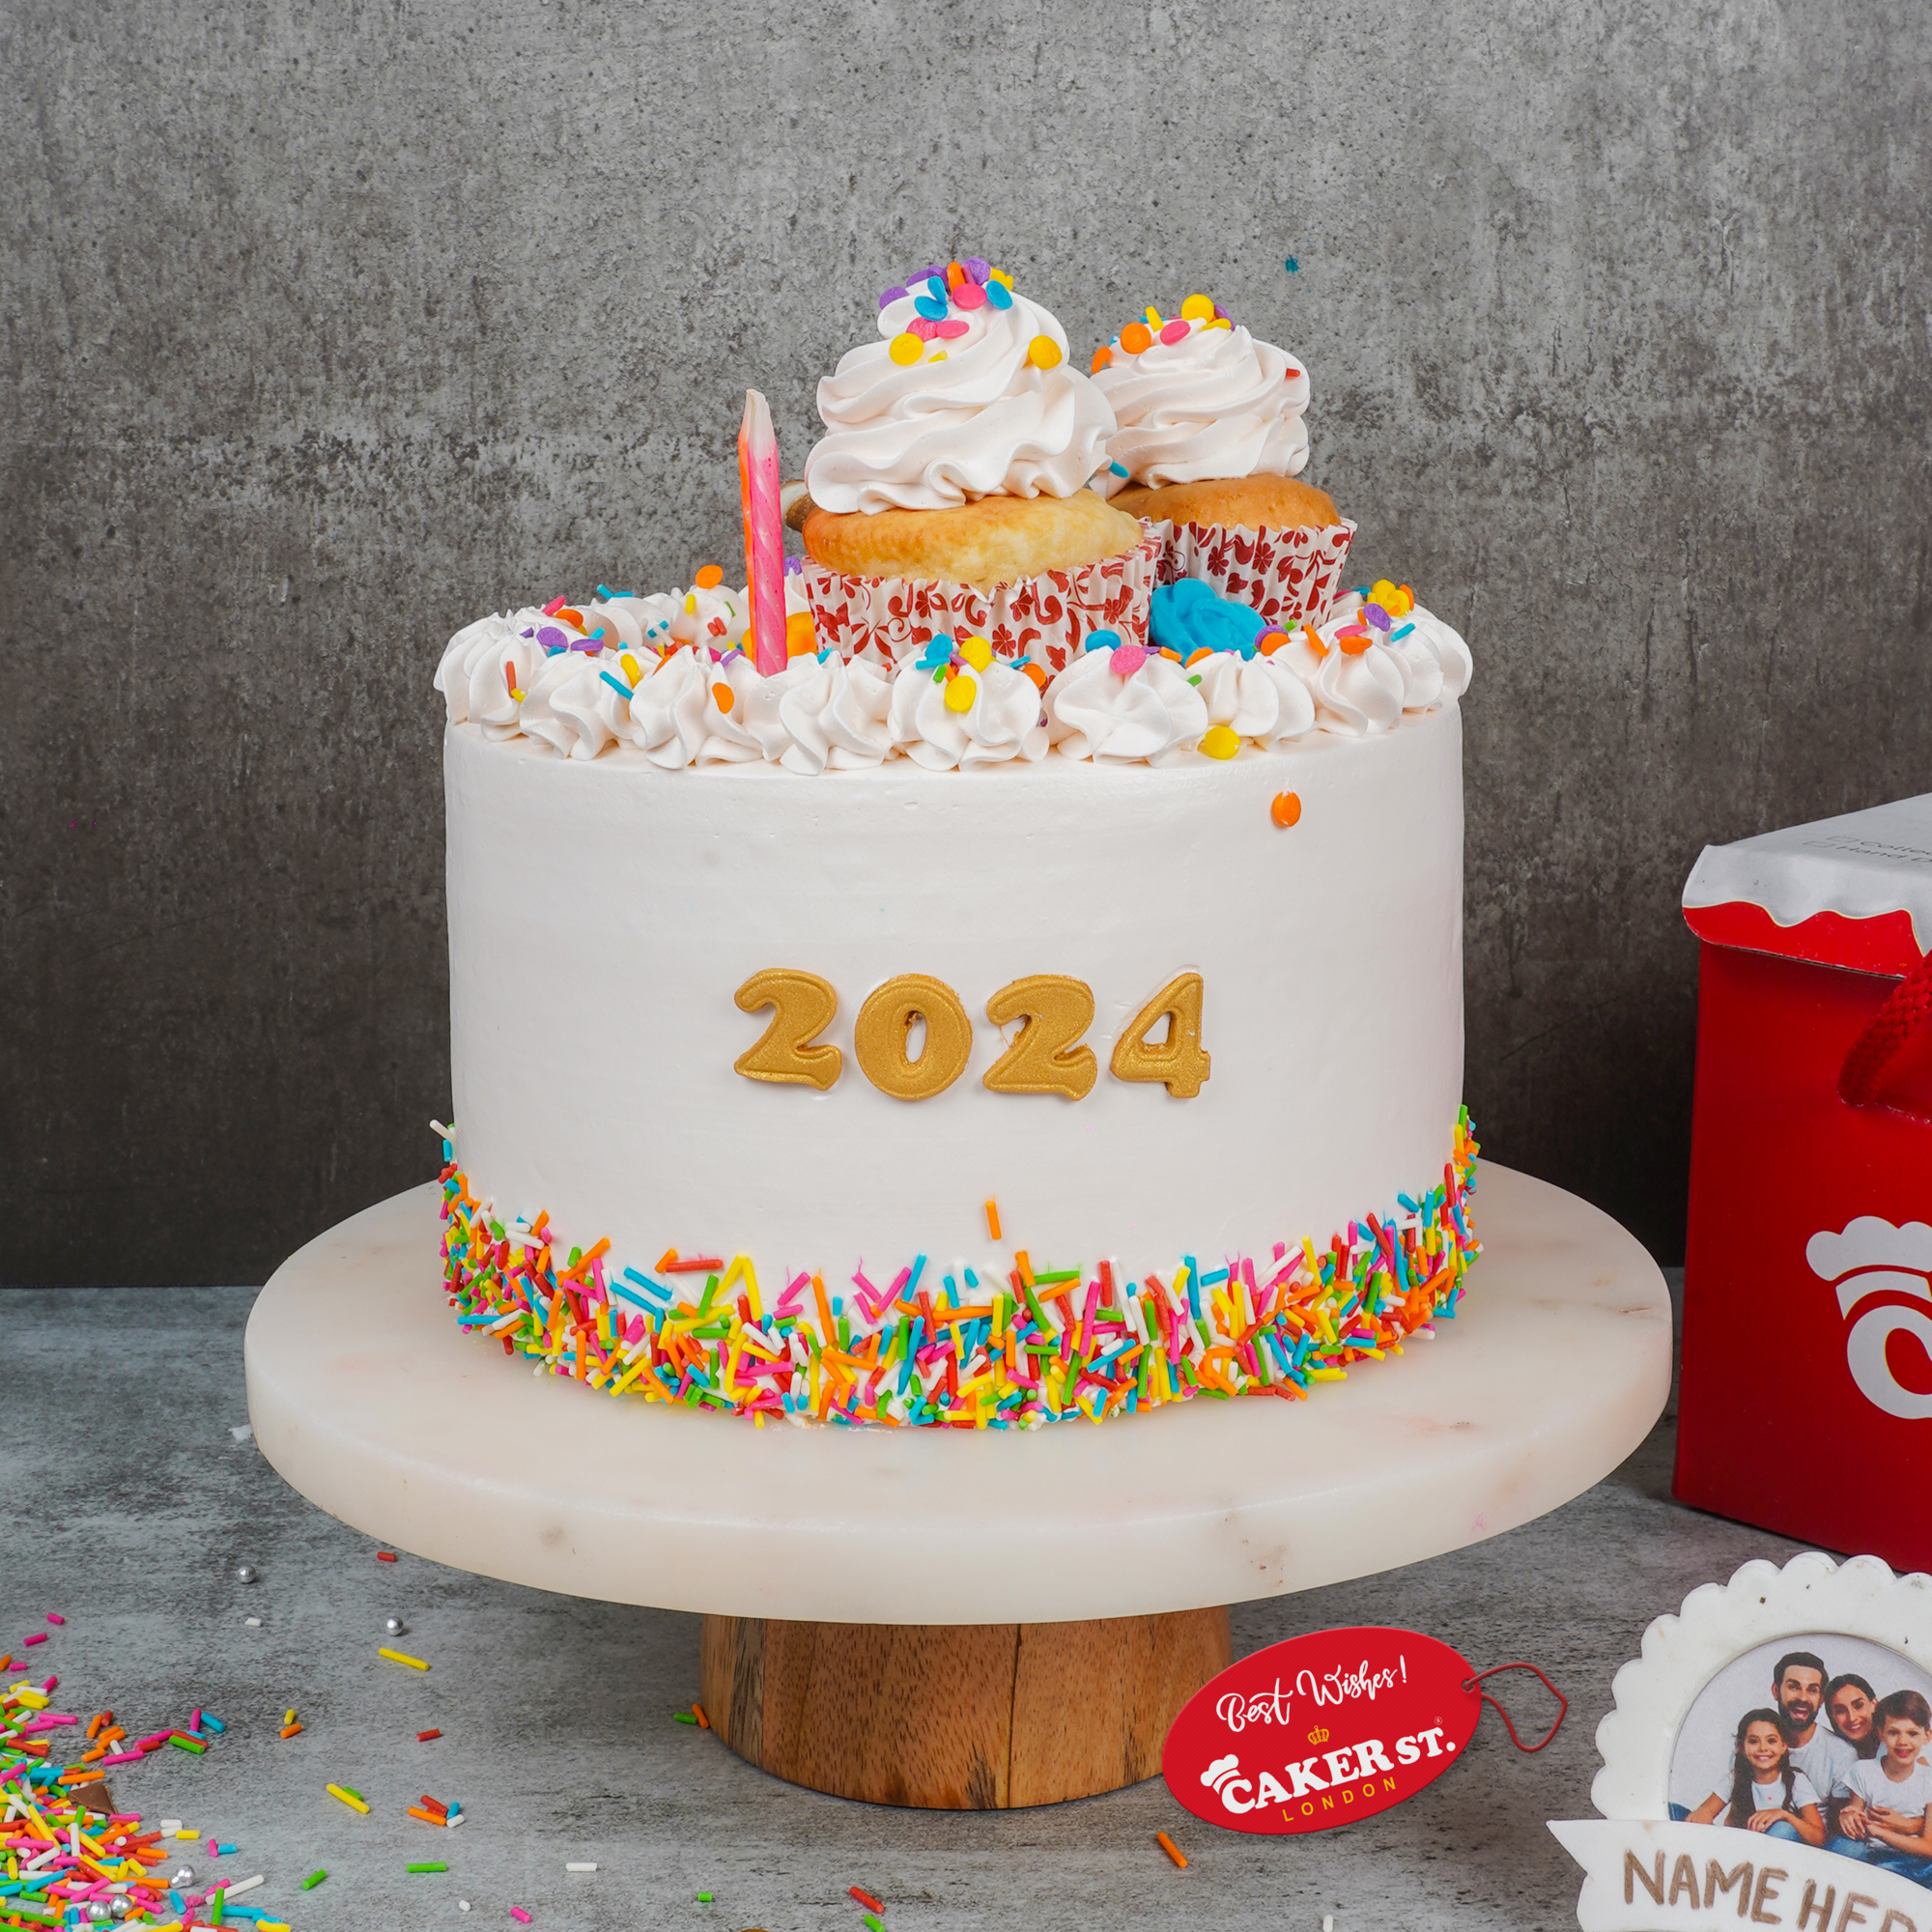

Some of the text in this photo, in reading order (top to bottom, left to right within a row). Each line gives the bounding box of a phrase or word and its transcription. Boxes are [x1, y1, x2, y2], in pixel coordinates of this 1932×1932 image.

[1835, 845, 1909, 859] Hand
[734, 966, 1210, 1101] 2024
[1215, 1655, 1407, 1733] Best Wishes!
[1221, 1726, 1457, 1814] CAKER ST.
[1282, 1776, 1397, 1822] LONDON
[1624, 1849, 1788, 1924] NAME
